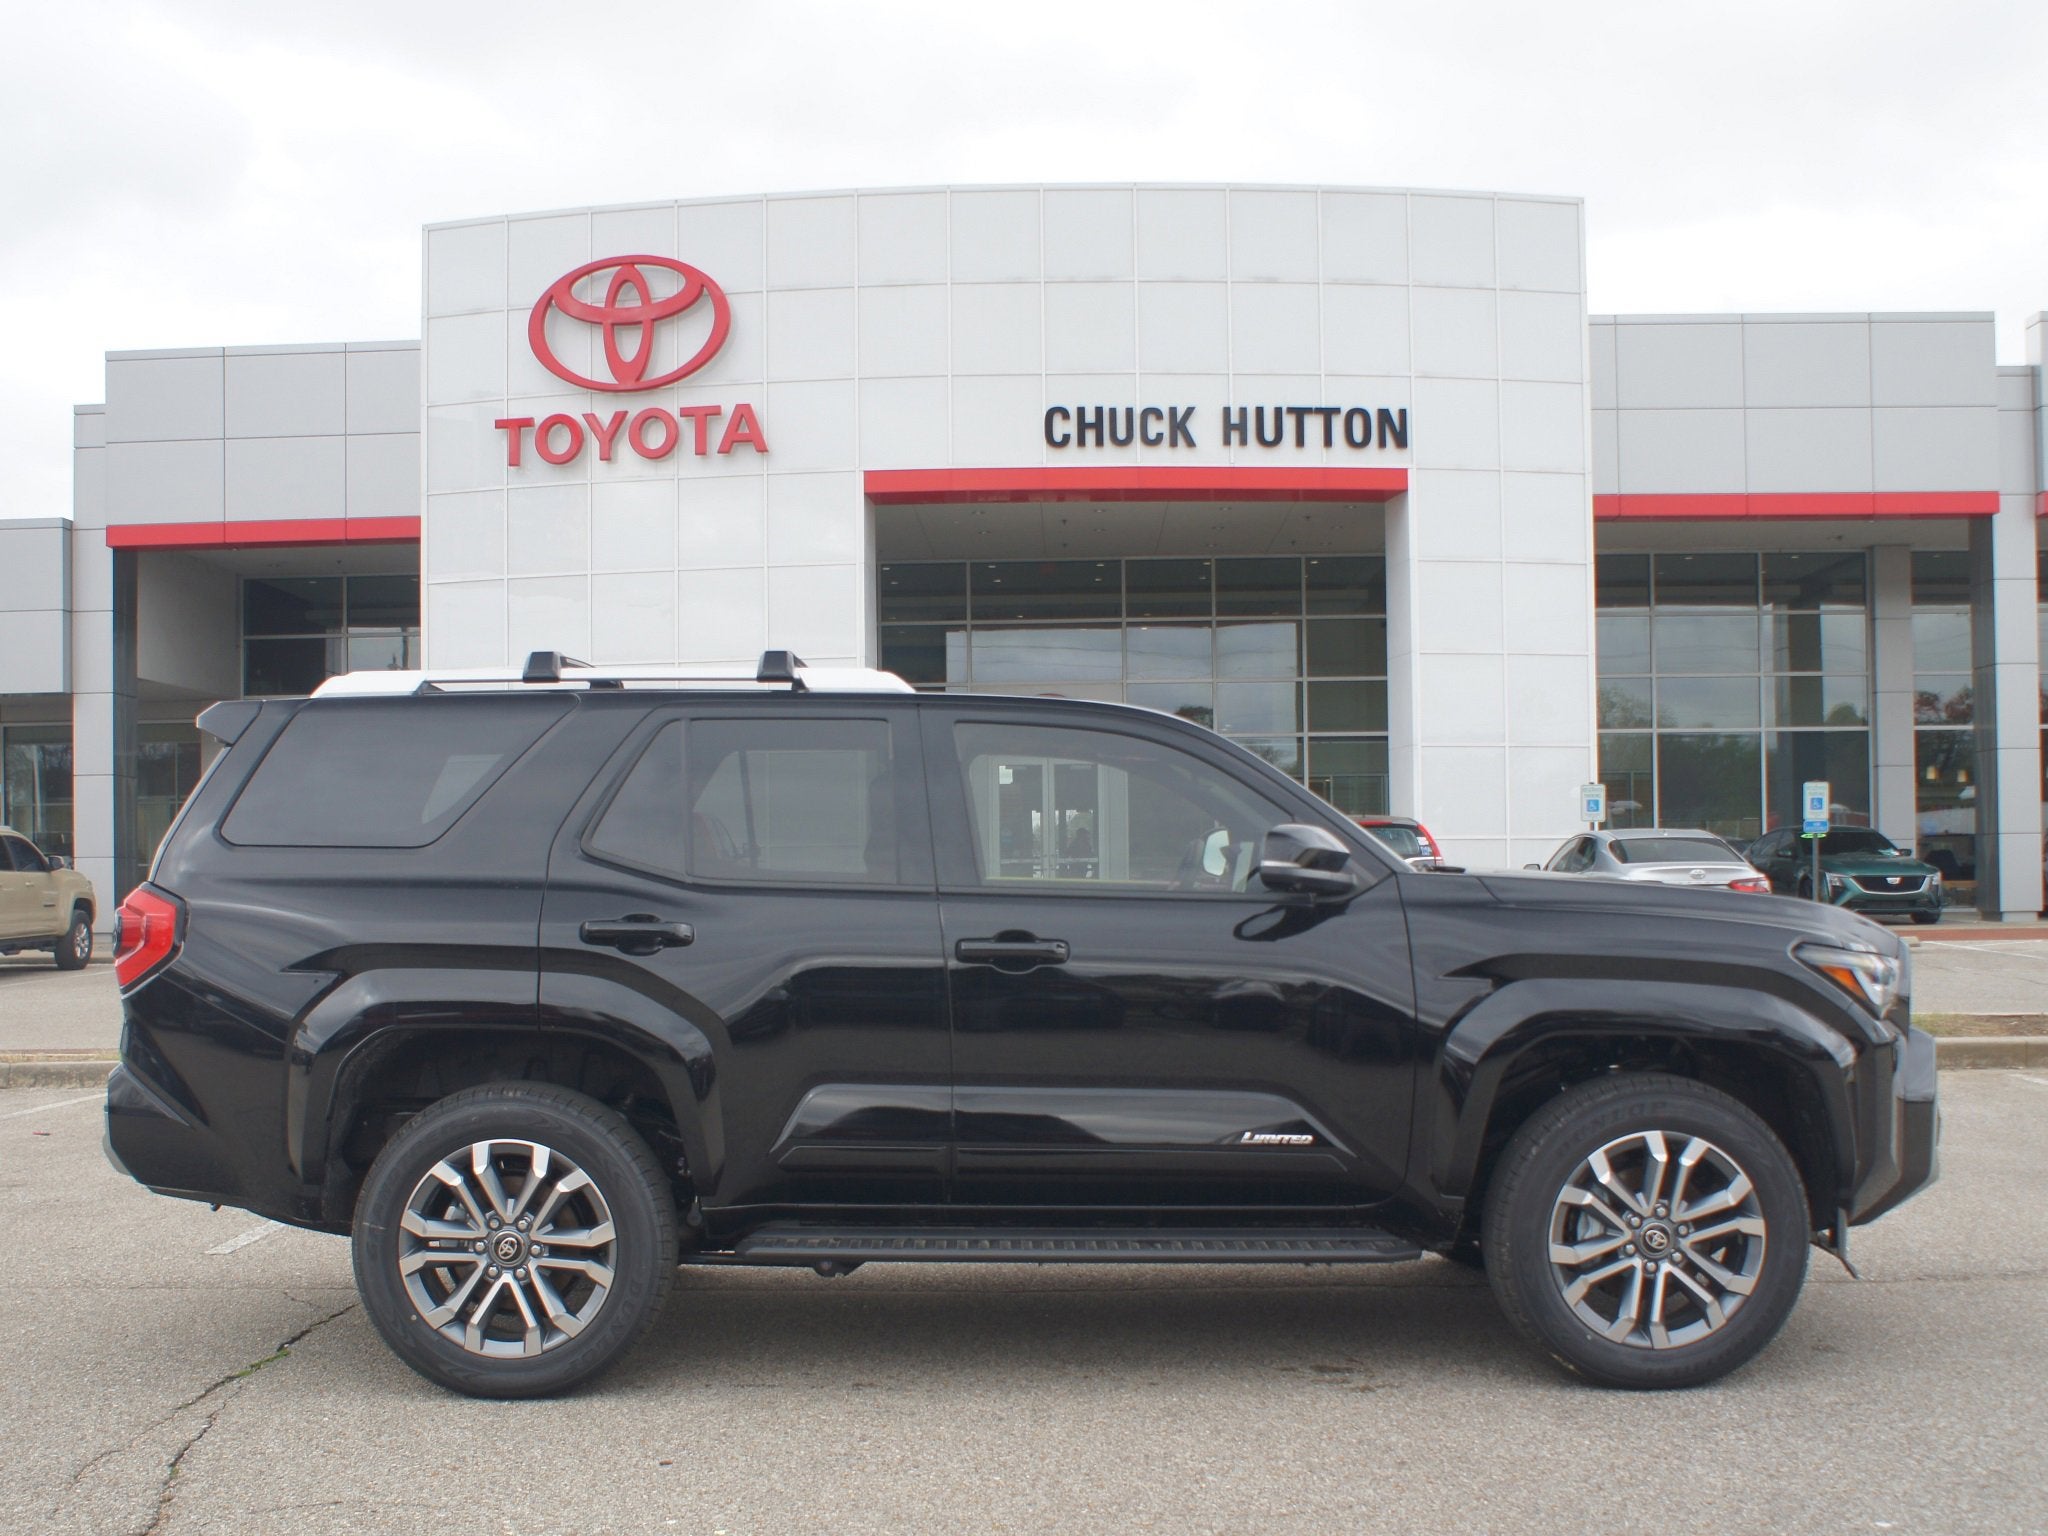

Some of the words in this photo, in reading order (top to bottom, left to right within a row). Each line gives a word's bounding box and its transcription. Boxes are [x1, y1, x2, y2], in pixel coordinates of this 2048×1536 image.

[495, 404, 769, 467] TOYOTA
[1044, 406, 1197, 448] CHUCK
[1222, 406, 1409, 449] HUTTON
[1241, 1131, 1314, 1145] LIMITED
